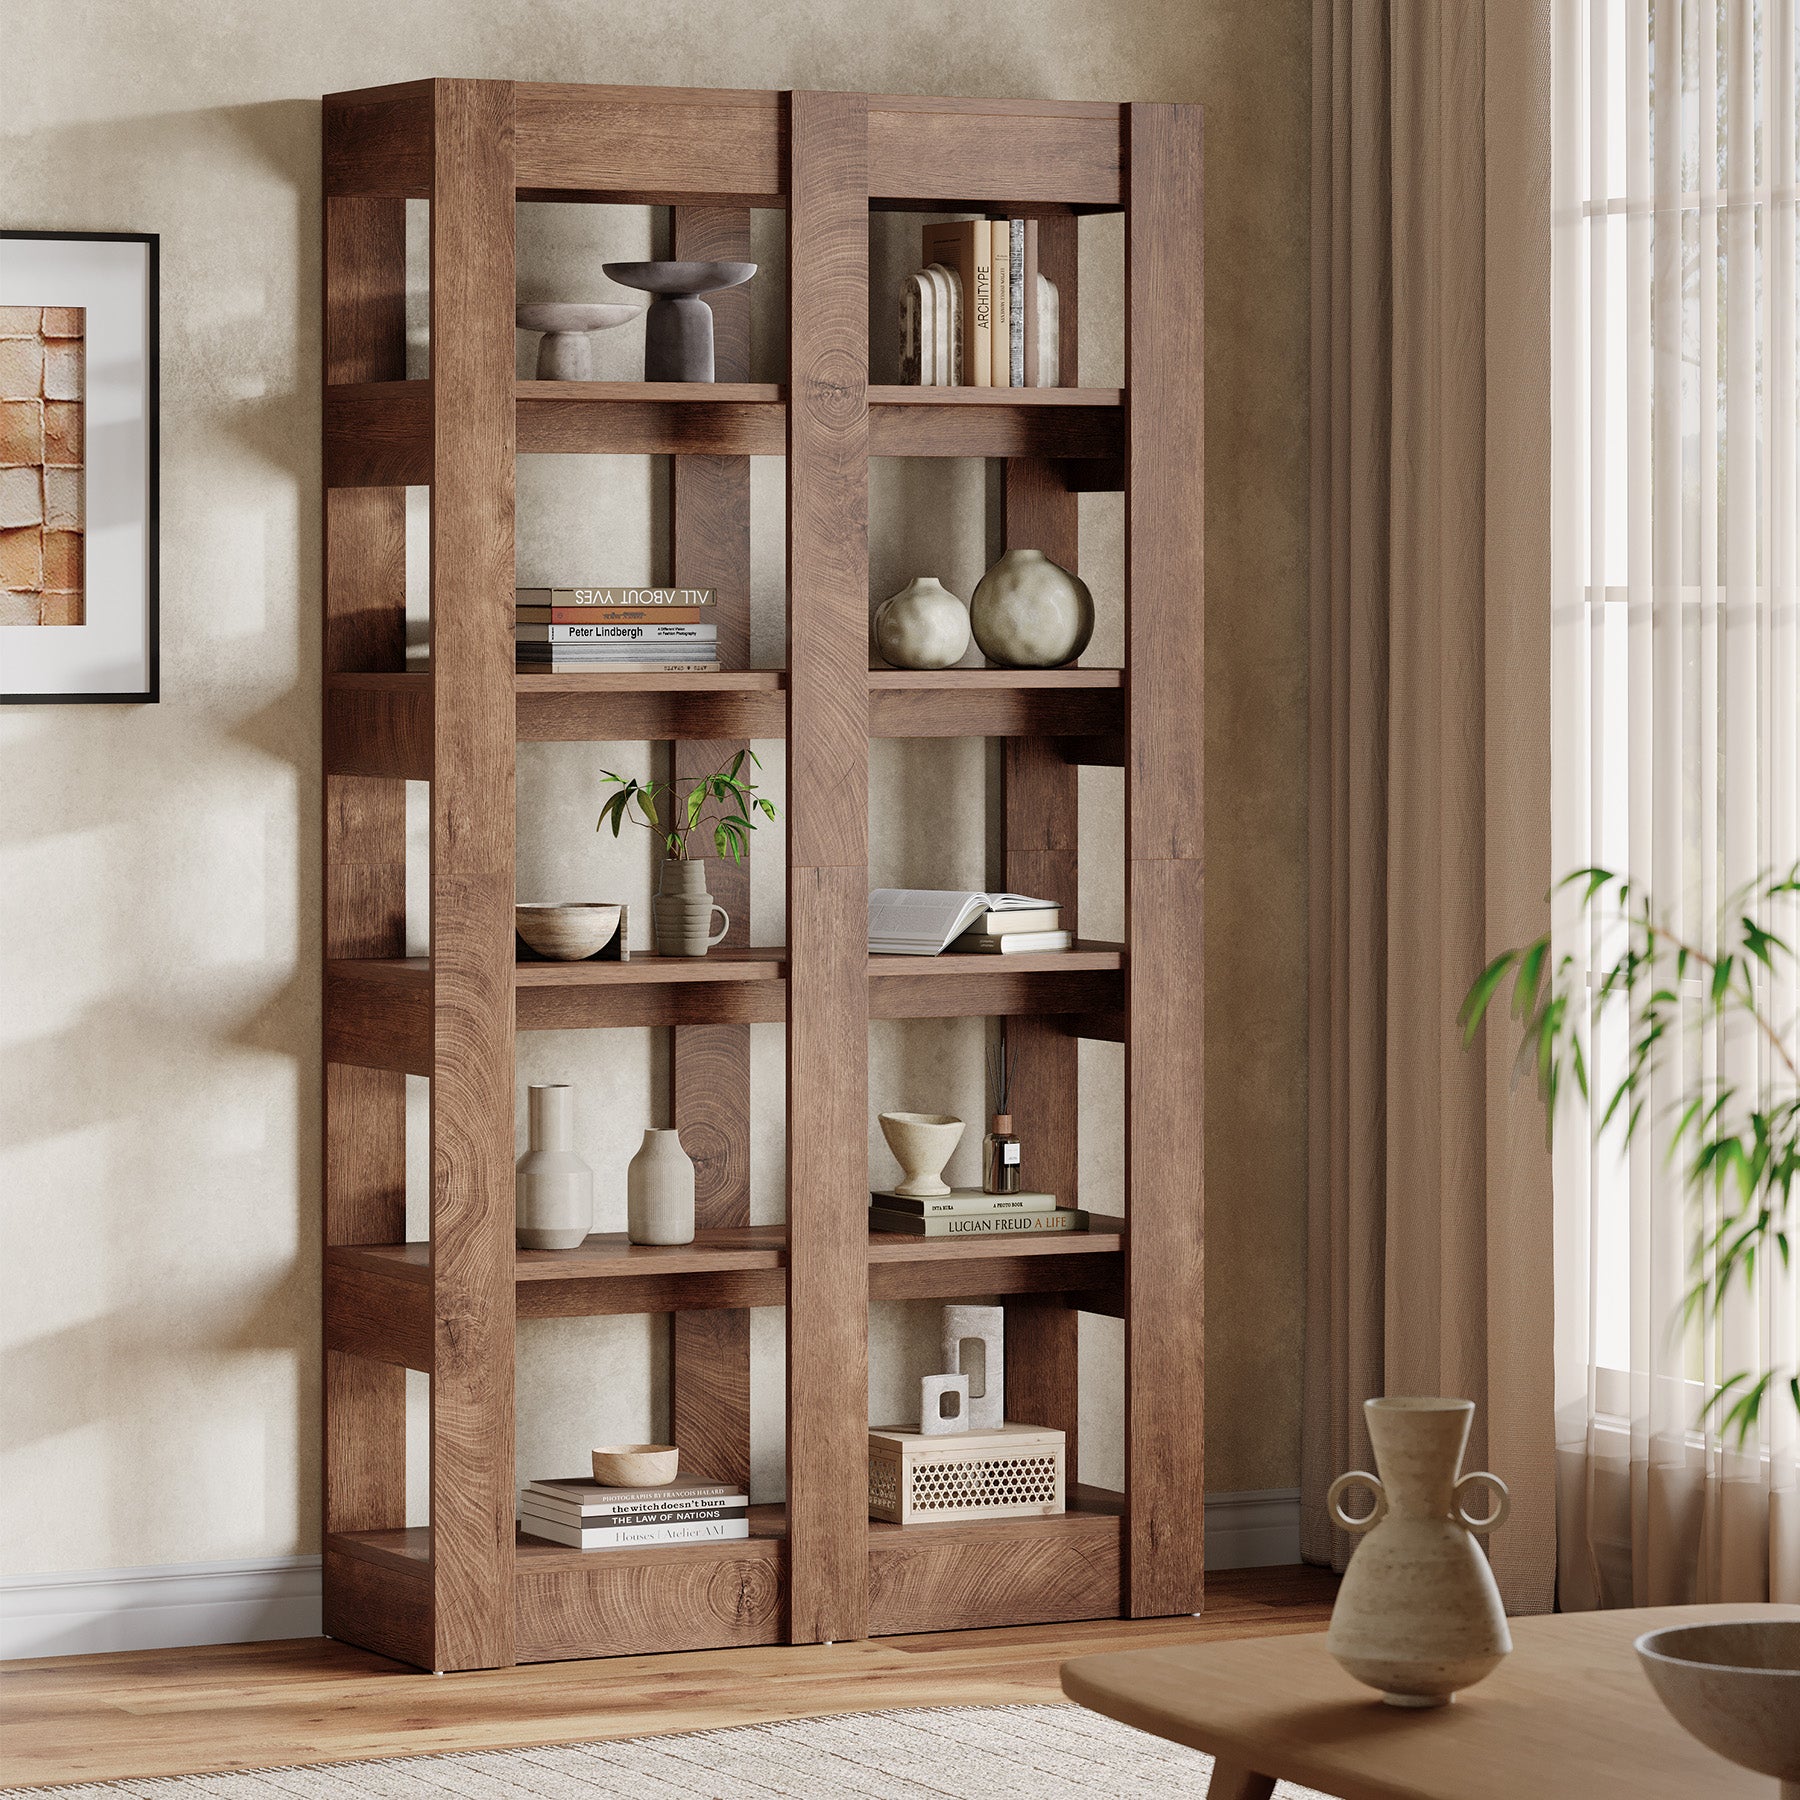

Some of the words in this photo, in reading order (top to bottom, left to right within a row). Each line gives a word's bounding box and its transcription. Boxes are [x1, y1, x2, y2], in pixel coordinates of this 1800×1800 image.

[978, 266, 989, 330] ARCHITYPE
[575, 590, 614, 604] YVES
[620, 590, 676, 604] ABOUT
[681, 590, 710, 604] ALL
[569, 627, 594, 637] Peter
[595, 626, 643, 640] Lindbergh
[949, 1219, 992, 1233] LUCIAN
[995, 1218, 1032, 1230] FREUD
[1034, 1218, 1043, 1228] A
[1046, 1216, 1067, 1228] LIFE
[602, 1493, 653, 1502] PHOTOGRAPHS
[663, 1490, 697, 1499] FRANÇOIS
[697, 1488, 724, 1496] HALARD
[701, 1499, 726, 1508] burn
[612, 1517, 633, 1525] THE
[636, 1515, 657, 1523] LAW
[659, 1513, 674, 1522] OF
[676, 1510, 721, 1520] NATIONS
[616, 1532, 655, 1542] Houses
[667, 1527, 700, 1538] Atelier
